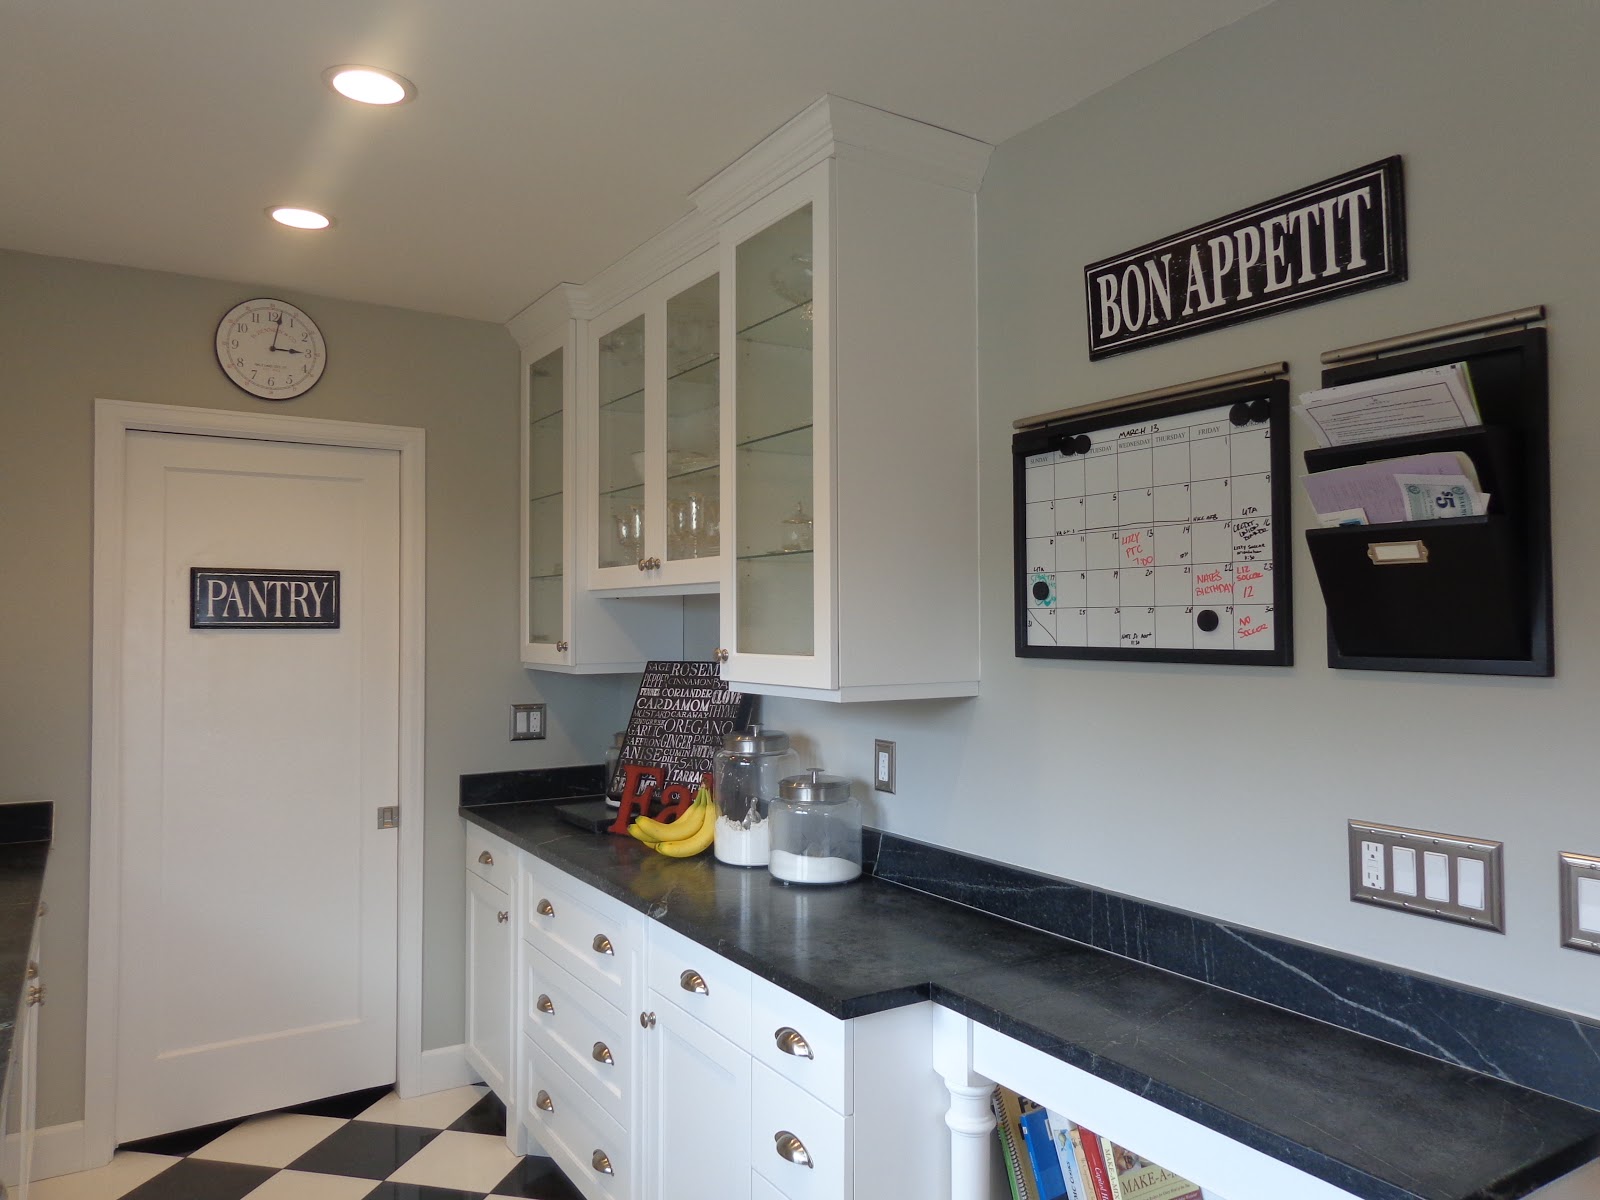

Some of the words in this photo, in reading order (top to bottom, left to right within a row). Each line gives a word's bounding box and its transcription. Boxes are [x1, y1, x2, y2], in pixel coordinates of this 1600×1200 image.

[1096, 253, 1172, 340] BON
[1182, 186, 1372, 316] APPETIT
[252, 313, 260, 323] 11
[268, 312, 279, 322] 12
[237, 323, 248, 333] 10
[290, 318, 294, 328] 1
[301, 333, 308, 342] 2
[232, 340, 239, 350] 9
[304, 349, 311, 359] 3
[237, 358, 244, 368] 8
[301, 365, 307, 374] 4
[251, 370, 258, 380] 7
[286, 375, 293, 385] 5
[268, 377, 275, 386] 6
[1118, 426, 1146, 438] MARCH
[1150, 424, 1159, 433] 13
[1198, 426, 1220, 436] FRIDAY
[1156, 432, 1185, 442] THURSDAY
[1118, 439, 1150, 449] WEDNESDAY
[1183, 525, 1190, 534] 14
[1195, 582, 1235, 596] BIRTHDAY
[1243, 586, 1254, 598] 12
[206, 580, 329, 618] PANTRY
[1239, 616, 1251, 626] NO
[648, 663, 669, 671] SAGE
[668, 677, 713, 686] CINNAMON
[662, 688, 713, 698] CORIANDER
[636, 697, 710, 712] CARDAMOM
[633, 710, 671, 719] MUSTARD
[671, 710, 710, 719] CARAWAY
[709, 705, 738, 718] THYME
[627, 724, 663, 738] GARLIC
[664, 718, 734, 735] OREGANO
[626, 737, 661, 747] SAFFRON
[660, 734, 693, 750] GINGER
[621, 746, 663, 762] ANISE
[663, 748, 691, 757] CUMIN
